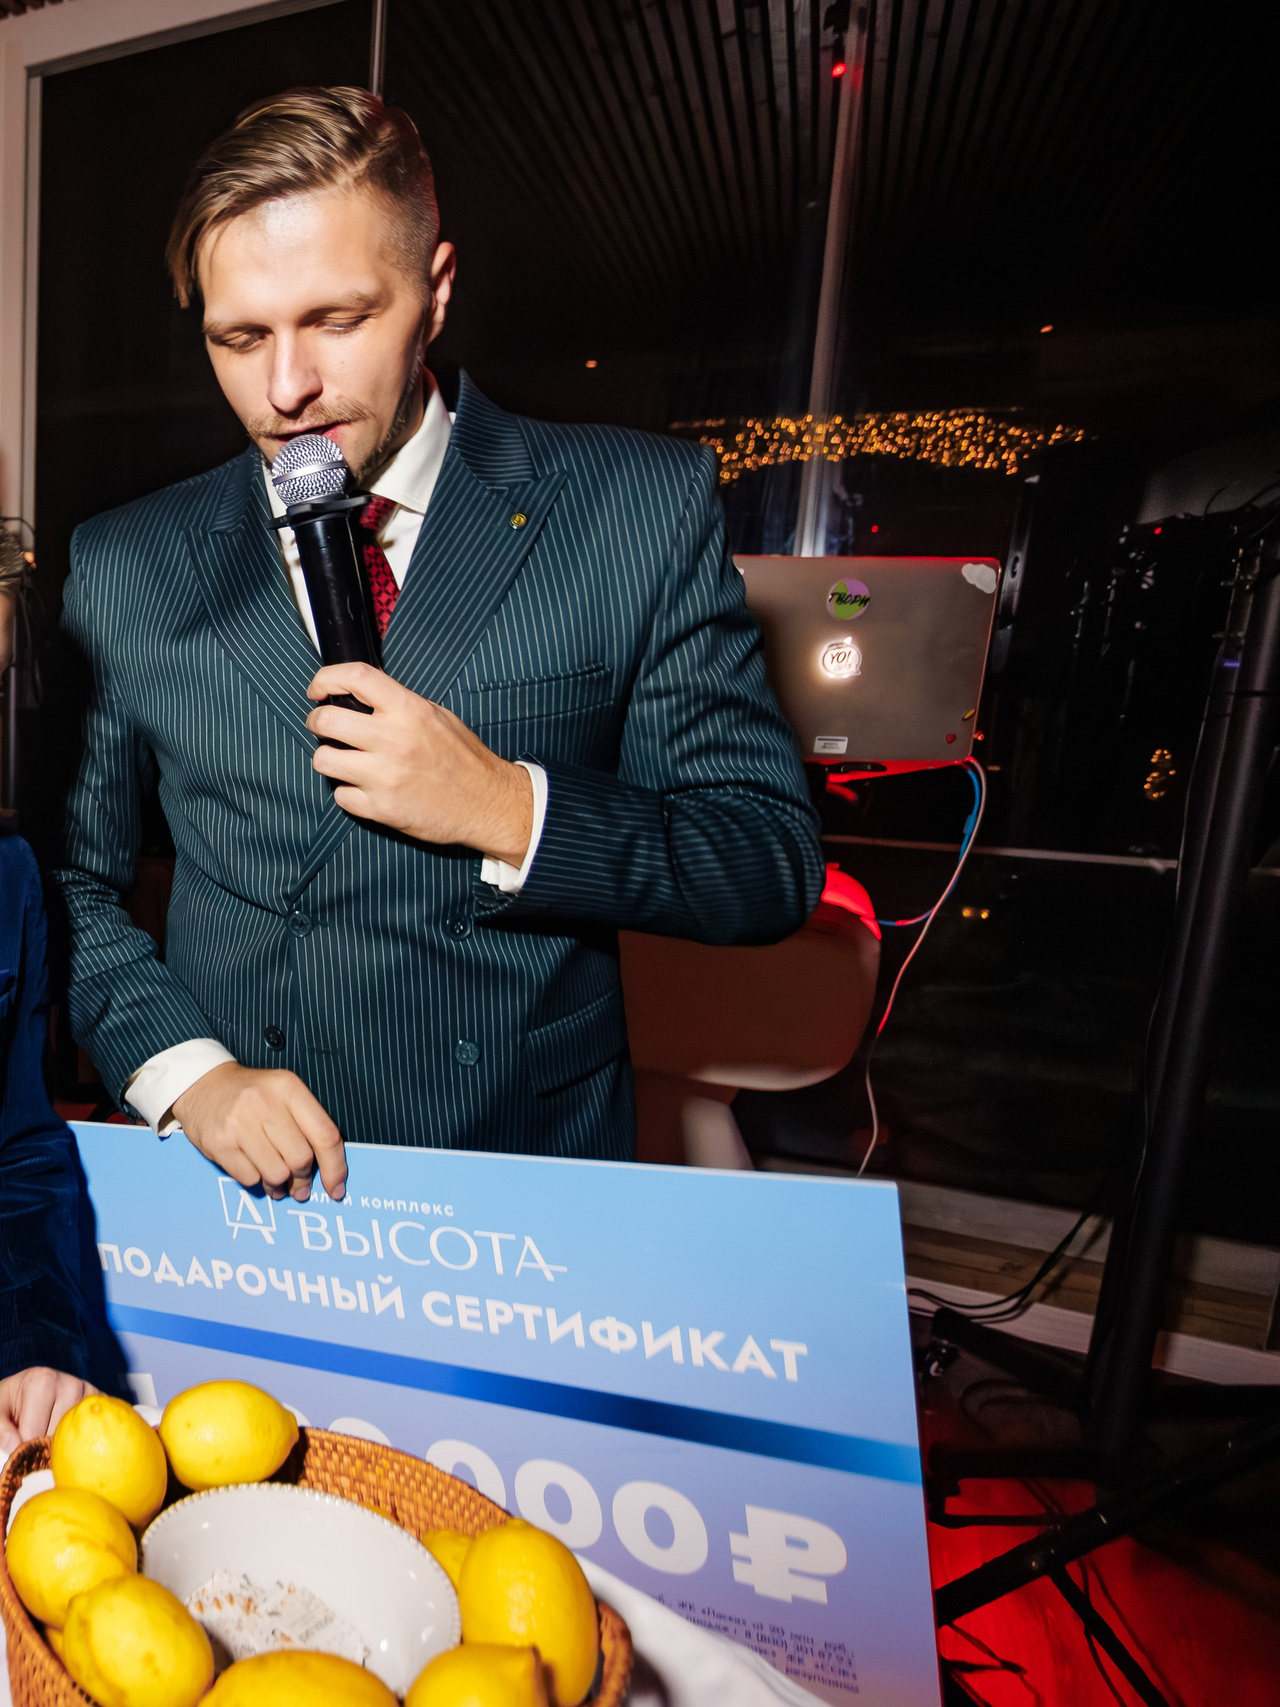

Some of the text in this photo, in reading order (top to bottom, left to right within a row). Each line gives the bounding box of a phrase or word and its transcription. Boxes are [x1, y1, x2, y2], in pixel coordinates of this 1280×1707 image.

[830, 650, 852, 665] YO!
[360, 1195, 455, 1218] комплекс
[286, 1208, 568, 1283] ВЫСОТА
[96, 1242, 809, 1383] ПОДАРОЧНЫЙ СЕРТИФИКАТ
